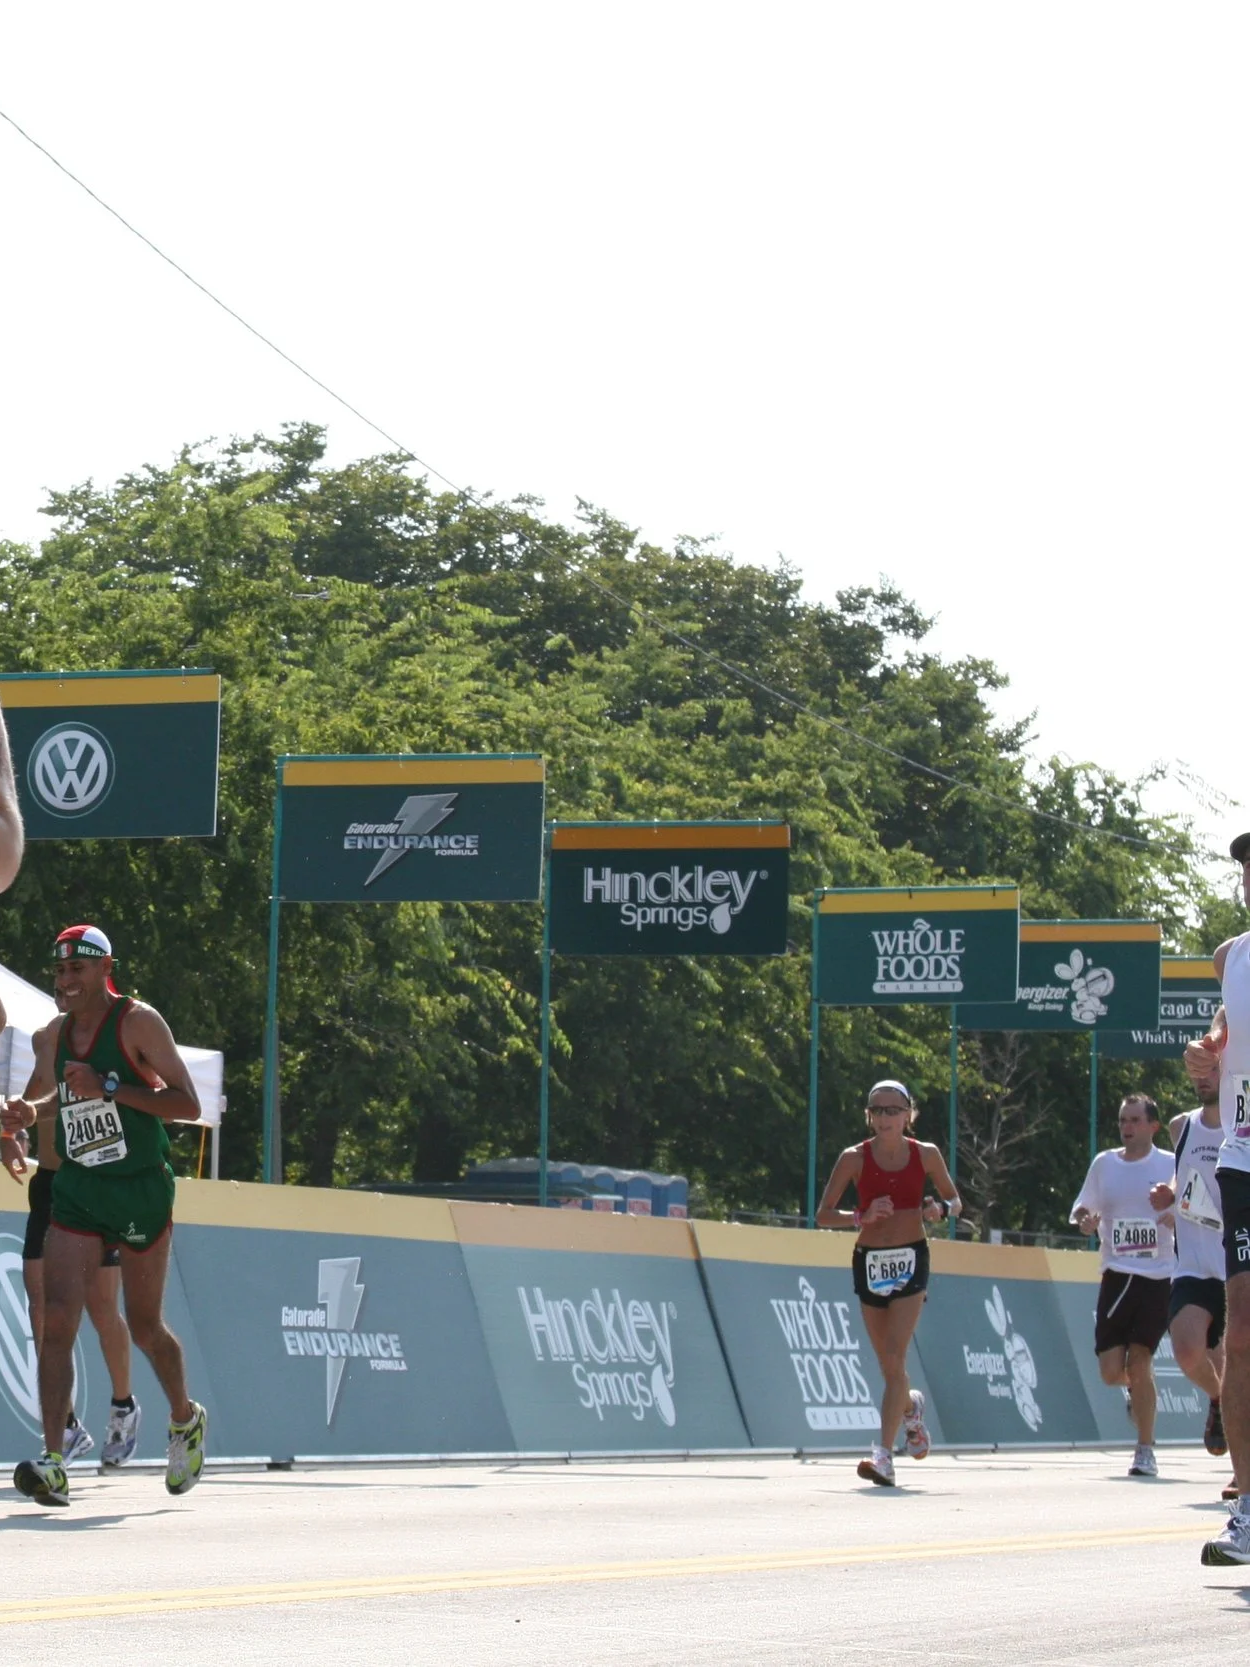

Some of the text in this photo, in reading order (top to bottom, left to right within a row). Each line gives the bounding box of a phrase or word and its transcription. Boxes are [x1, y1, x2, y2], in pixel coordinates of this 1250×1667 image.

[346, 822, 400, 835] Gatorade
[343, 835, 479, 850] ENDURANCE
[434, 849, 479, 857] FORMULA
[583, 865, 758, 915] Hinckley
[620, 903, 708, 932] Springs
[871, 928, 966, 955] WHOLE
[876, 954, 960, 981] FOODS
[879, 982, 956, 991] MARKET
[1017, 984, 1069, 1003] nergizer
[1160, 1002, 1193, 1018] cago
[67, 1112, 118, 1146] 24049
[1113, 1228, 1156, 1246] B 4088
[868, 1263, 876, 1280] C
[281, 1306, 326, 1328] Gatorade
[770, 1298, 860, 1350] WHOLE
[282, 1331, 404, 1358] ENDURANCE
[517, 1286, 675, 1389] Hinckley
[370, 1359, 408, 1371] FORMULA
[790, 1353, 871, 1404] FOODS
[572, 1362, 653, 1421] Springs
